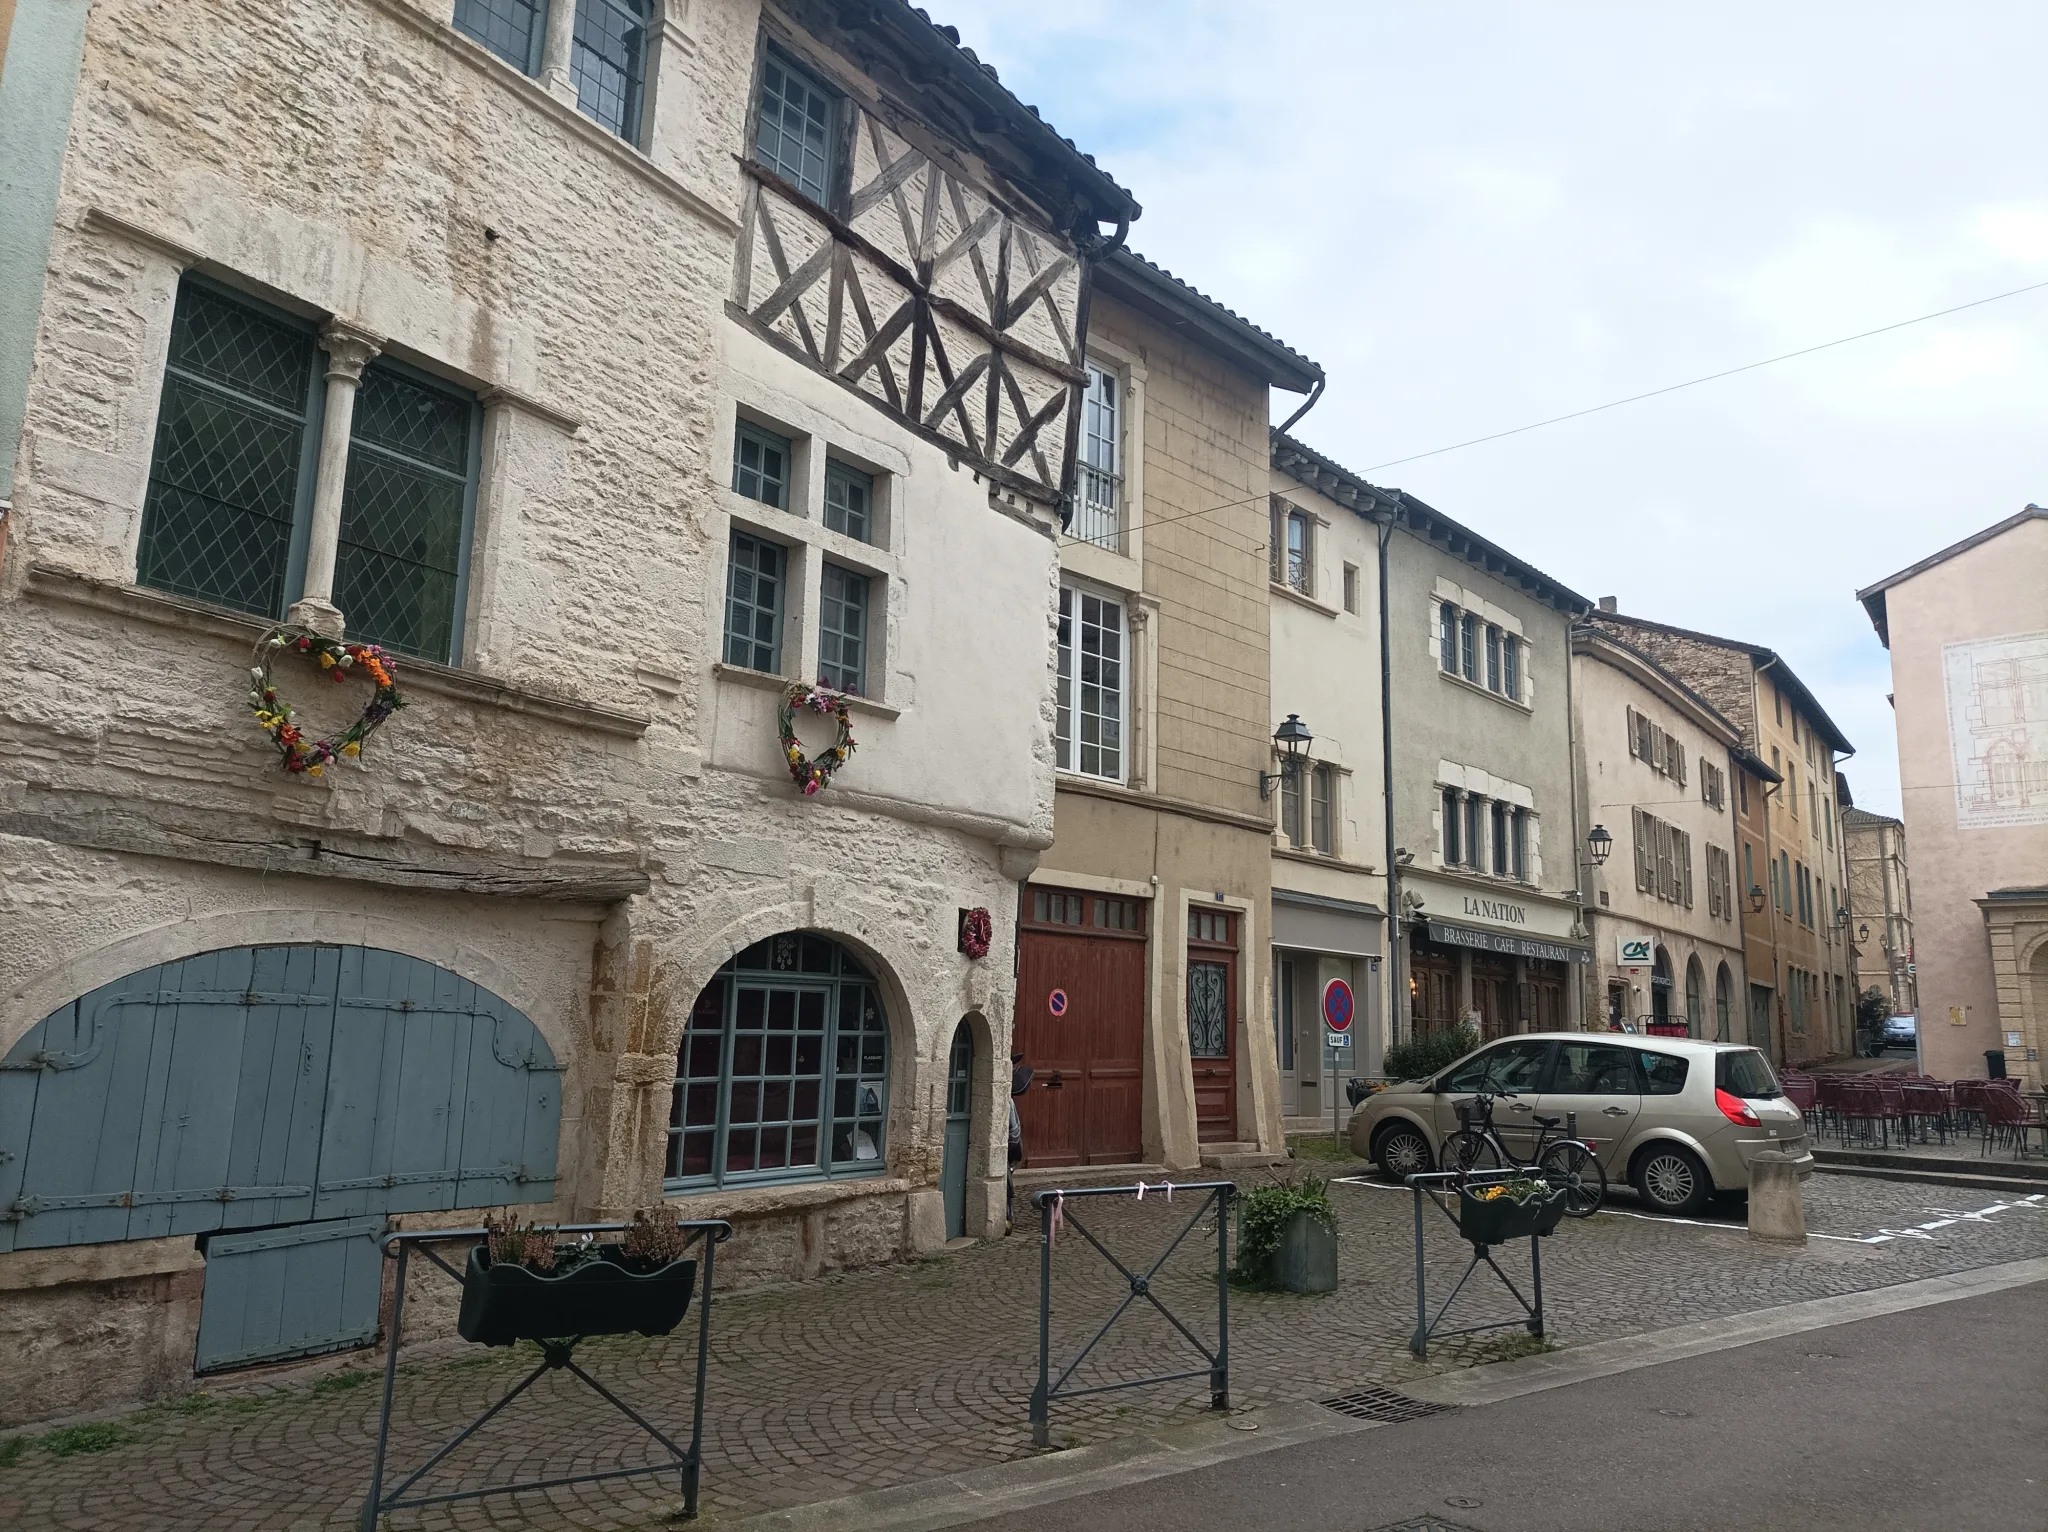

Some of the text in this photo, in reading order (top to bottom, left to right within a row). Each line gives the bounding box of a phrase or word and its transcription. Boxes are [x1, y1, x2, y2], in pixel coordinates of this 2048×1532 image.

[1463, 896, 1526, 924] LA NATION
[1443, 927, 1570, 961] BRASSERIE CAFE RESTAURANT
[1330, 1036, 1343, 1044] SAUF
